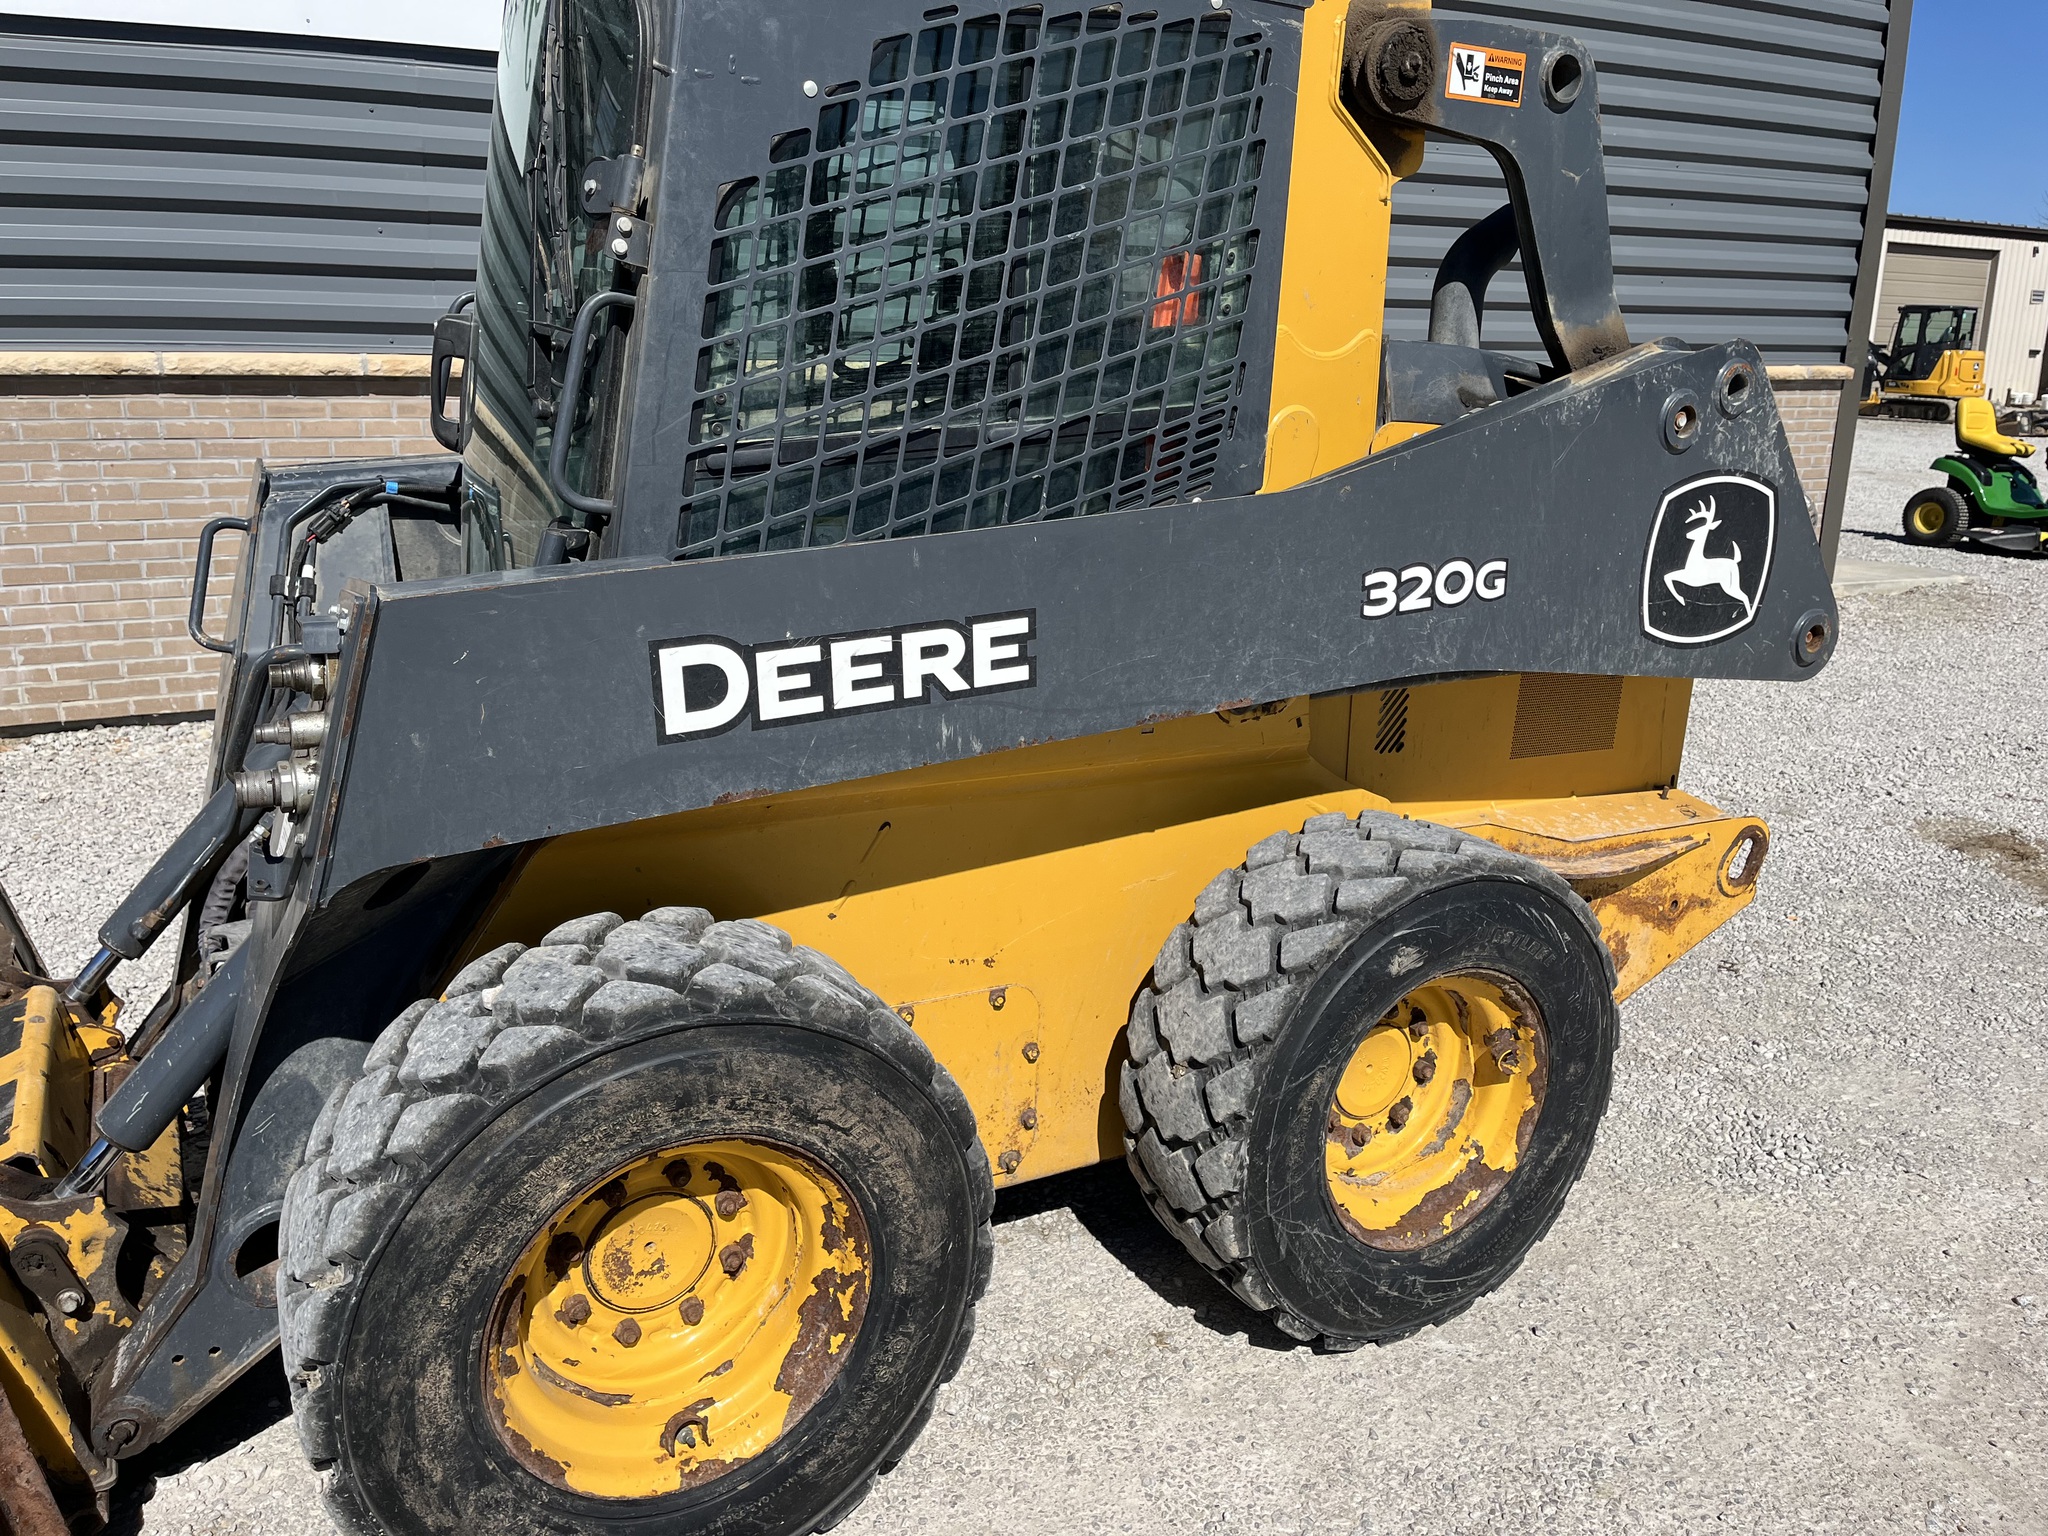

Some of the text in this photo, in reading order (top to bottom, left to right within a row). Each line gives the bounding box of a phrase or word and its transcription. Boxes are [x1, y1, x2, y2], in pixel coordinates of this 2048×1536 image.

[1494, 55, 1522, 66] WARNING
[1485, 72, 1519, 86] Pinch Area
[1483, 84, 1513, 97] Keep Away
[1362, 560, 1507, 617] 320G
[658, 616, 1030, 736] DEERE
